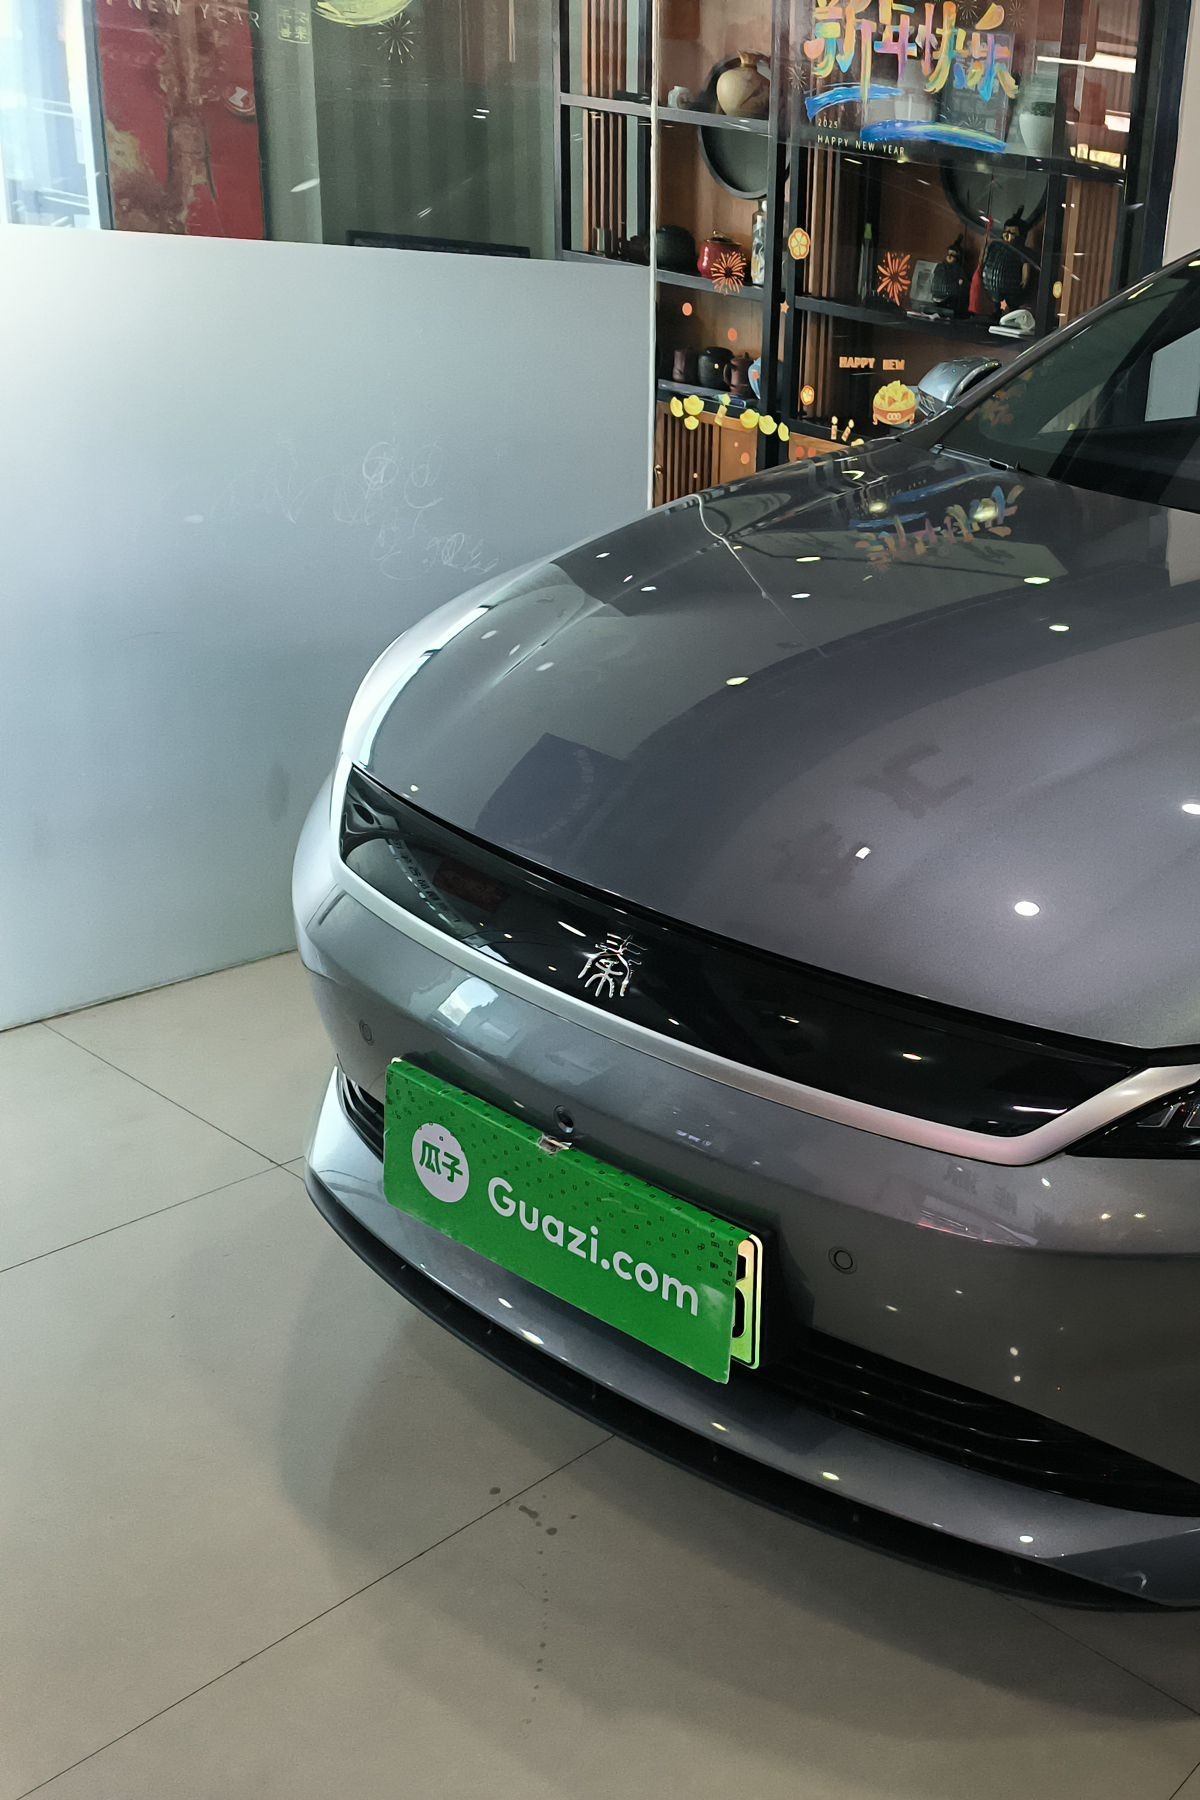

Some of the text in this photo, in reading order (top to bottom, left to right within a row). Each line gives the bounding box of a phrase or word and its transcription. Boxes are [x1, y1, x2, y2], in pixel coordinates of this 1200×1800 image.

[200, 4, 260, 29] YEAR
[804, 0, 1020, 103] 新年快乐
[817, 118, 838, 129] 2025
[817, 134, 905, 156] HAPPY NEW YEAR
[419, 1140, 464, 1183] 瓜子
[487, 1176, 699, 1317] Guazi.com
